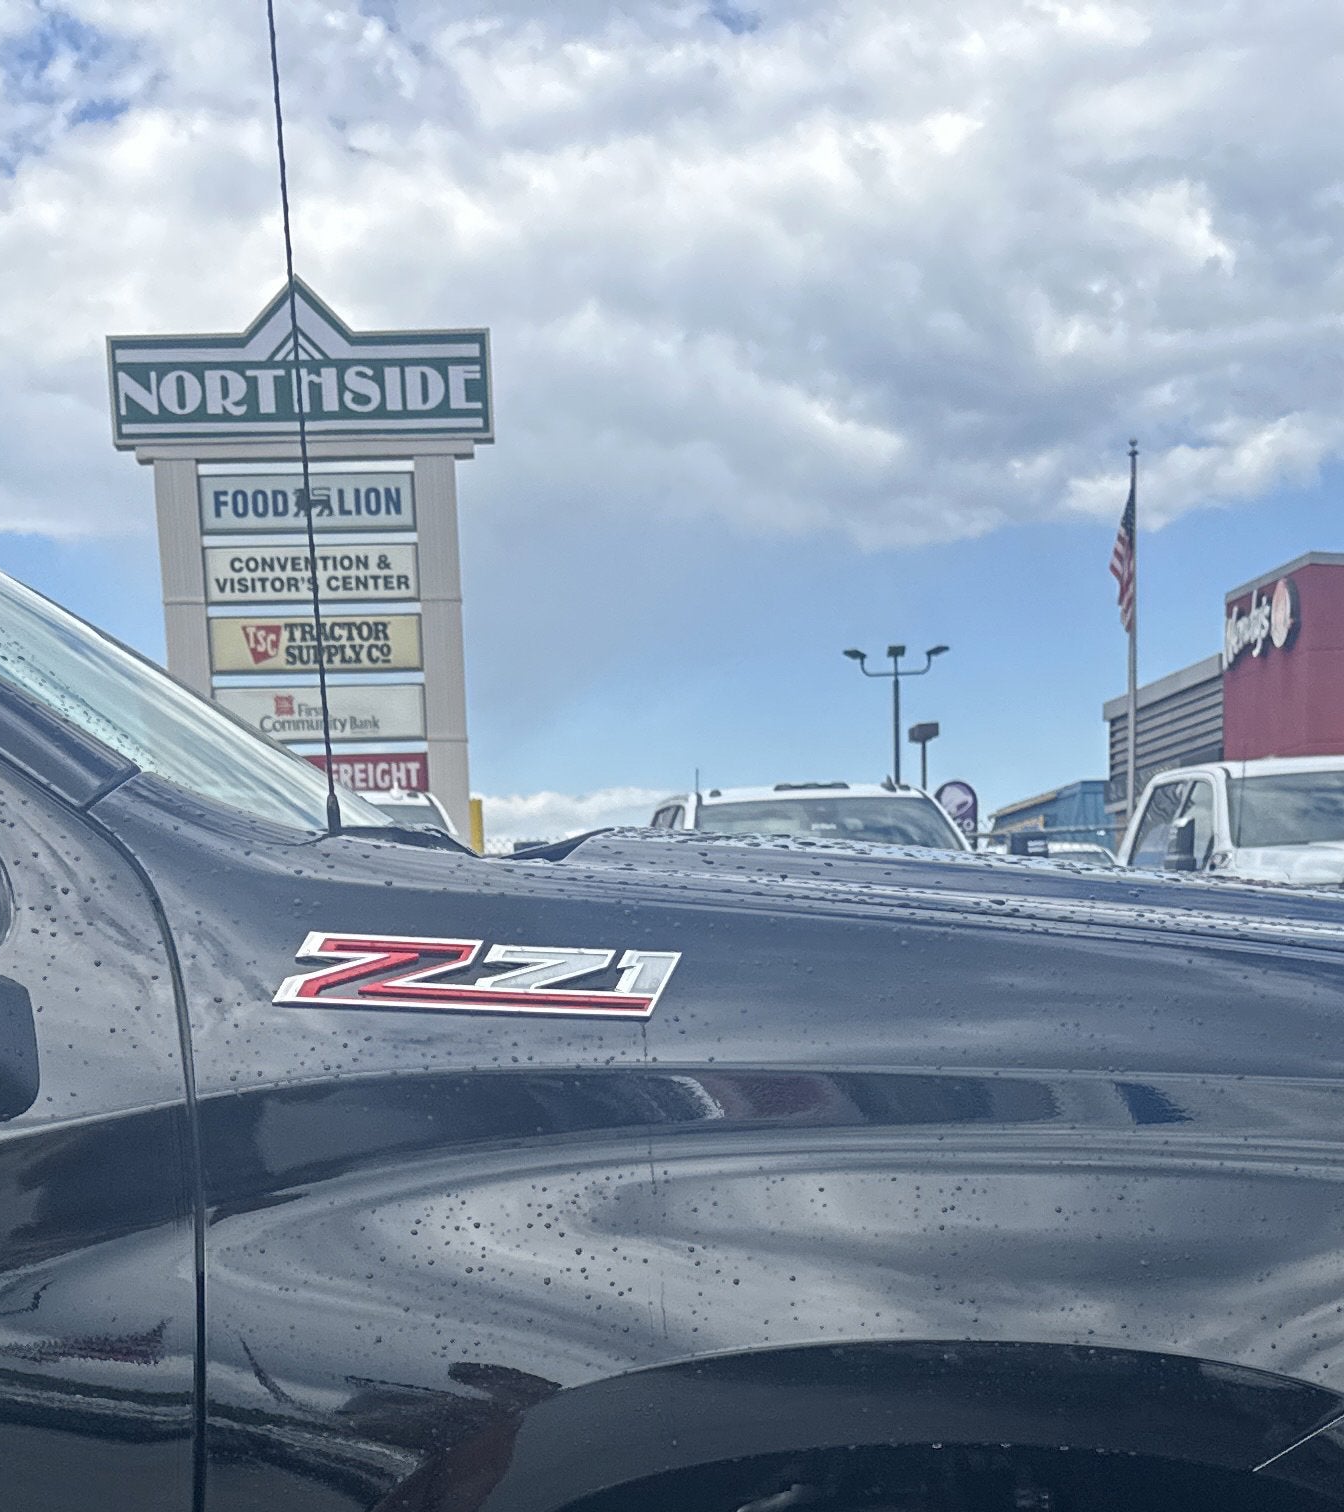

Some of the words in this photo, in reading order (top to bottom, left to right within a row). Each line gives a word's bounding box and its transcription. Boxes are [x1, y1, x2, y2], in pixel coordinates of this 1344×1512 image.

[117, 364, 483, 416] NORTHSIDE
[213, 488, 290, 518] FOOD
[338, 486, 403, 516] LION
[229, 555, 370, 573] CONVENTION
[377, 554, 392, 570] &
[215, 576, 319, 593] VISITOR'S
[326, 575, 411, 591] CENTER
[246, 626, 278, 657] TSC
[284, 621, 389, 643] TRACTOR
[285, 644, 363, 665] SUPPLY
[297, 703, 327, 718] Firs
[272, 931, 682, 1020] Z71
